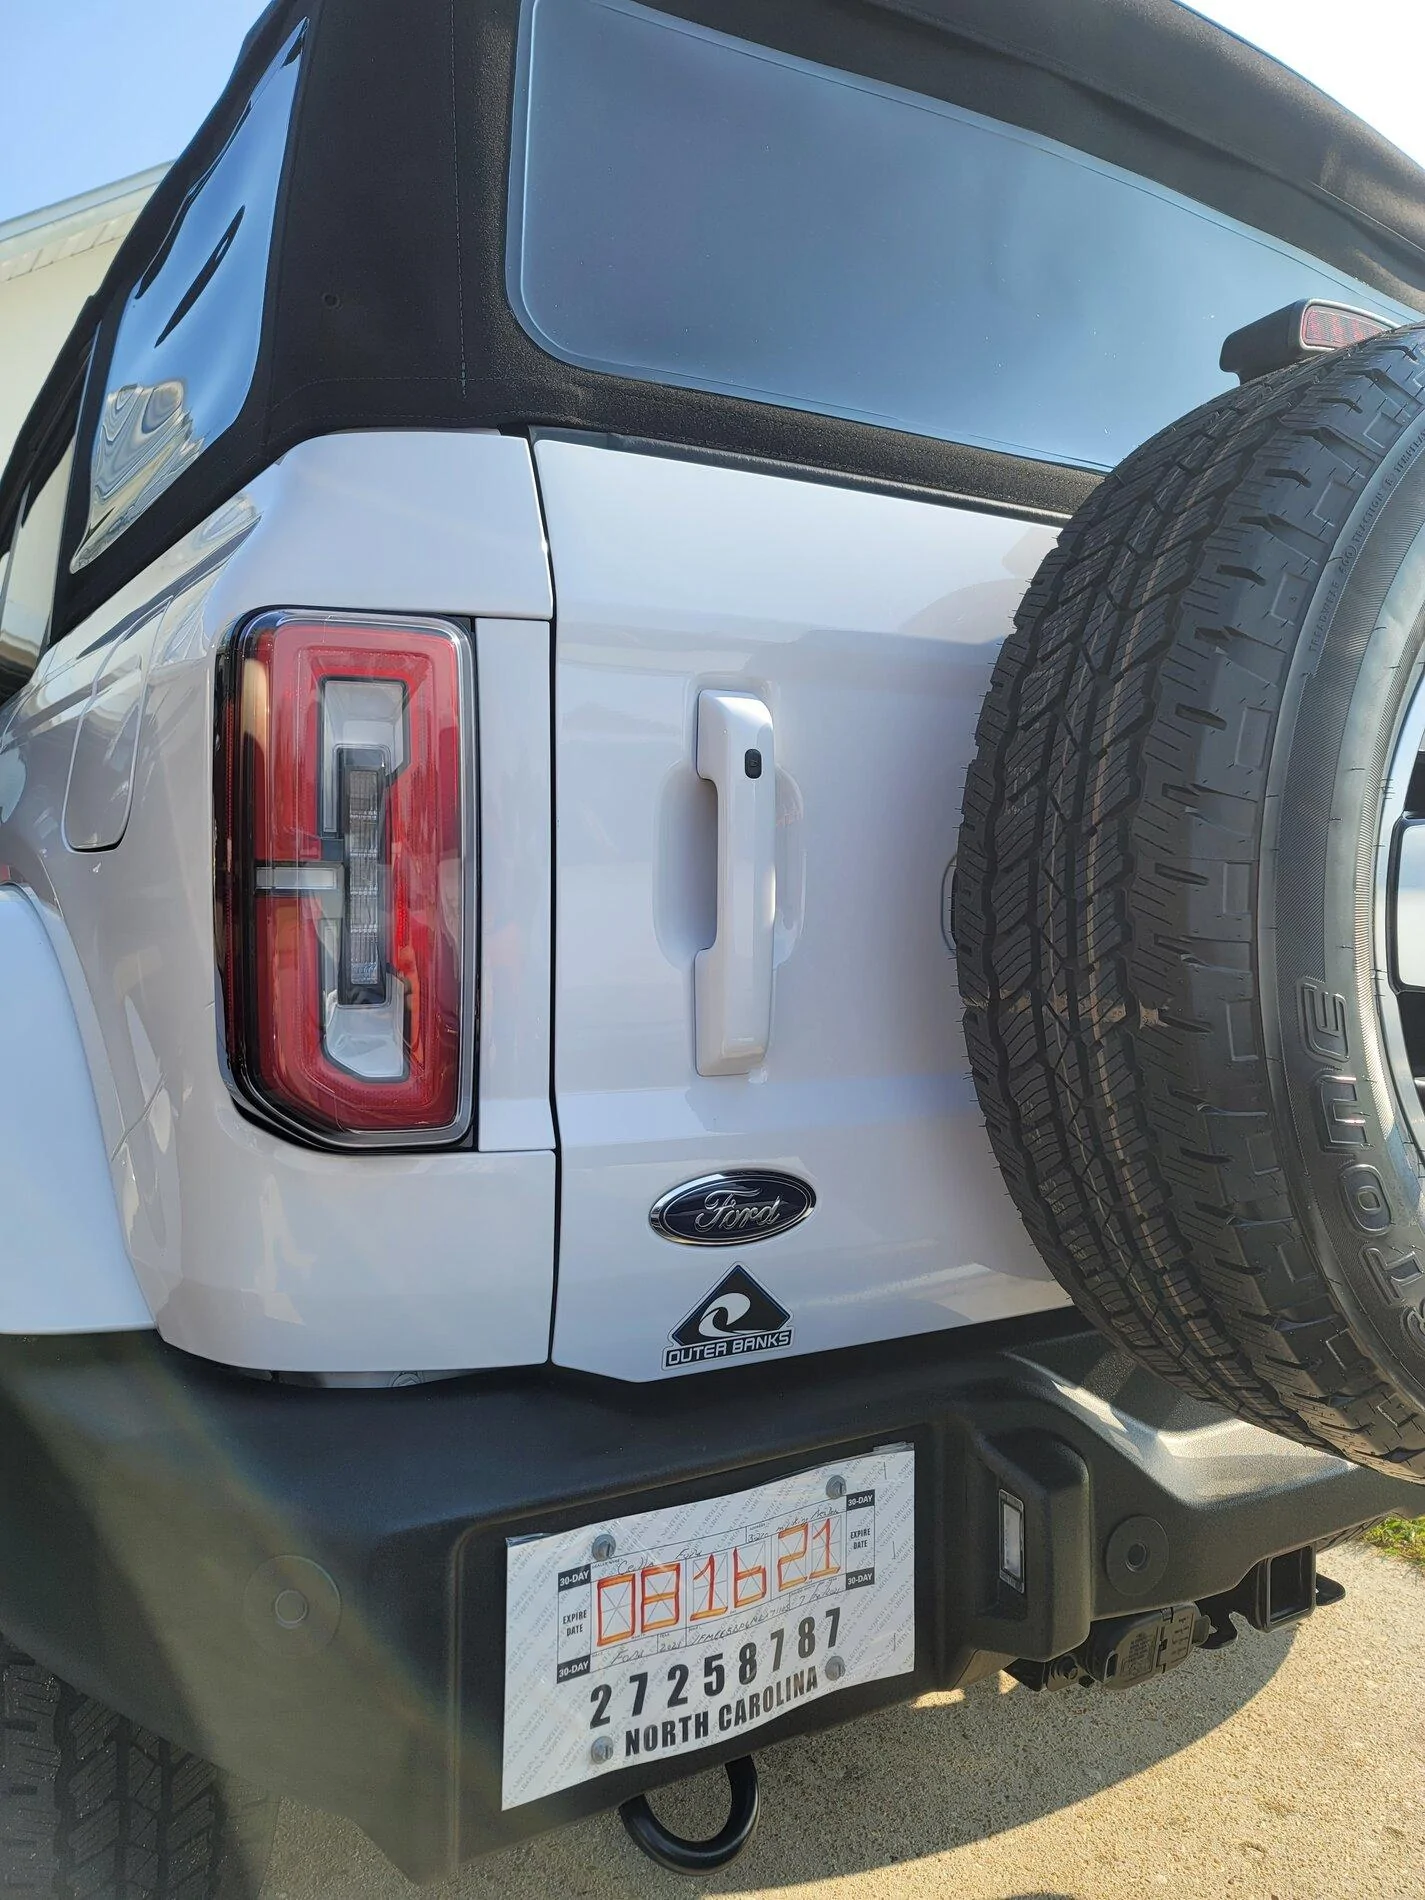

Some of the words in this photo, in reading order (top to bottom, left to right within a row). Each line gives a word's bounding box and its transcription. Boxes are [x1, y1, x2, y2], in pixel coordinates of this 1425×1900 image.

[694, 1187, 781, 1232] Ford
[667, 1343, 727, 1365] OUTER
[732, 1330, 791, 1354] BANKS
[848, 1495, 874, 1507] 30-DAY
[850, 1528, 871, 1540] EXPIRE
[853, 1540, 868, 1550] DATE
[559, 1569, 590, 1587] 30-DAY
[847, 1574, 873, 1586] 30-DAY
[562, 1609, 588, 1625] EXPIRE
[566, 1626, 584, 1637] DATE
[558, 1659, 589, 1678] 30-DAY
[589, 1607, 841, 1729] 27258787
[625, 1710, 709, 1757] NORTH
[718, 1665, 819, 1732] CAROLINA
